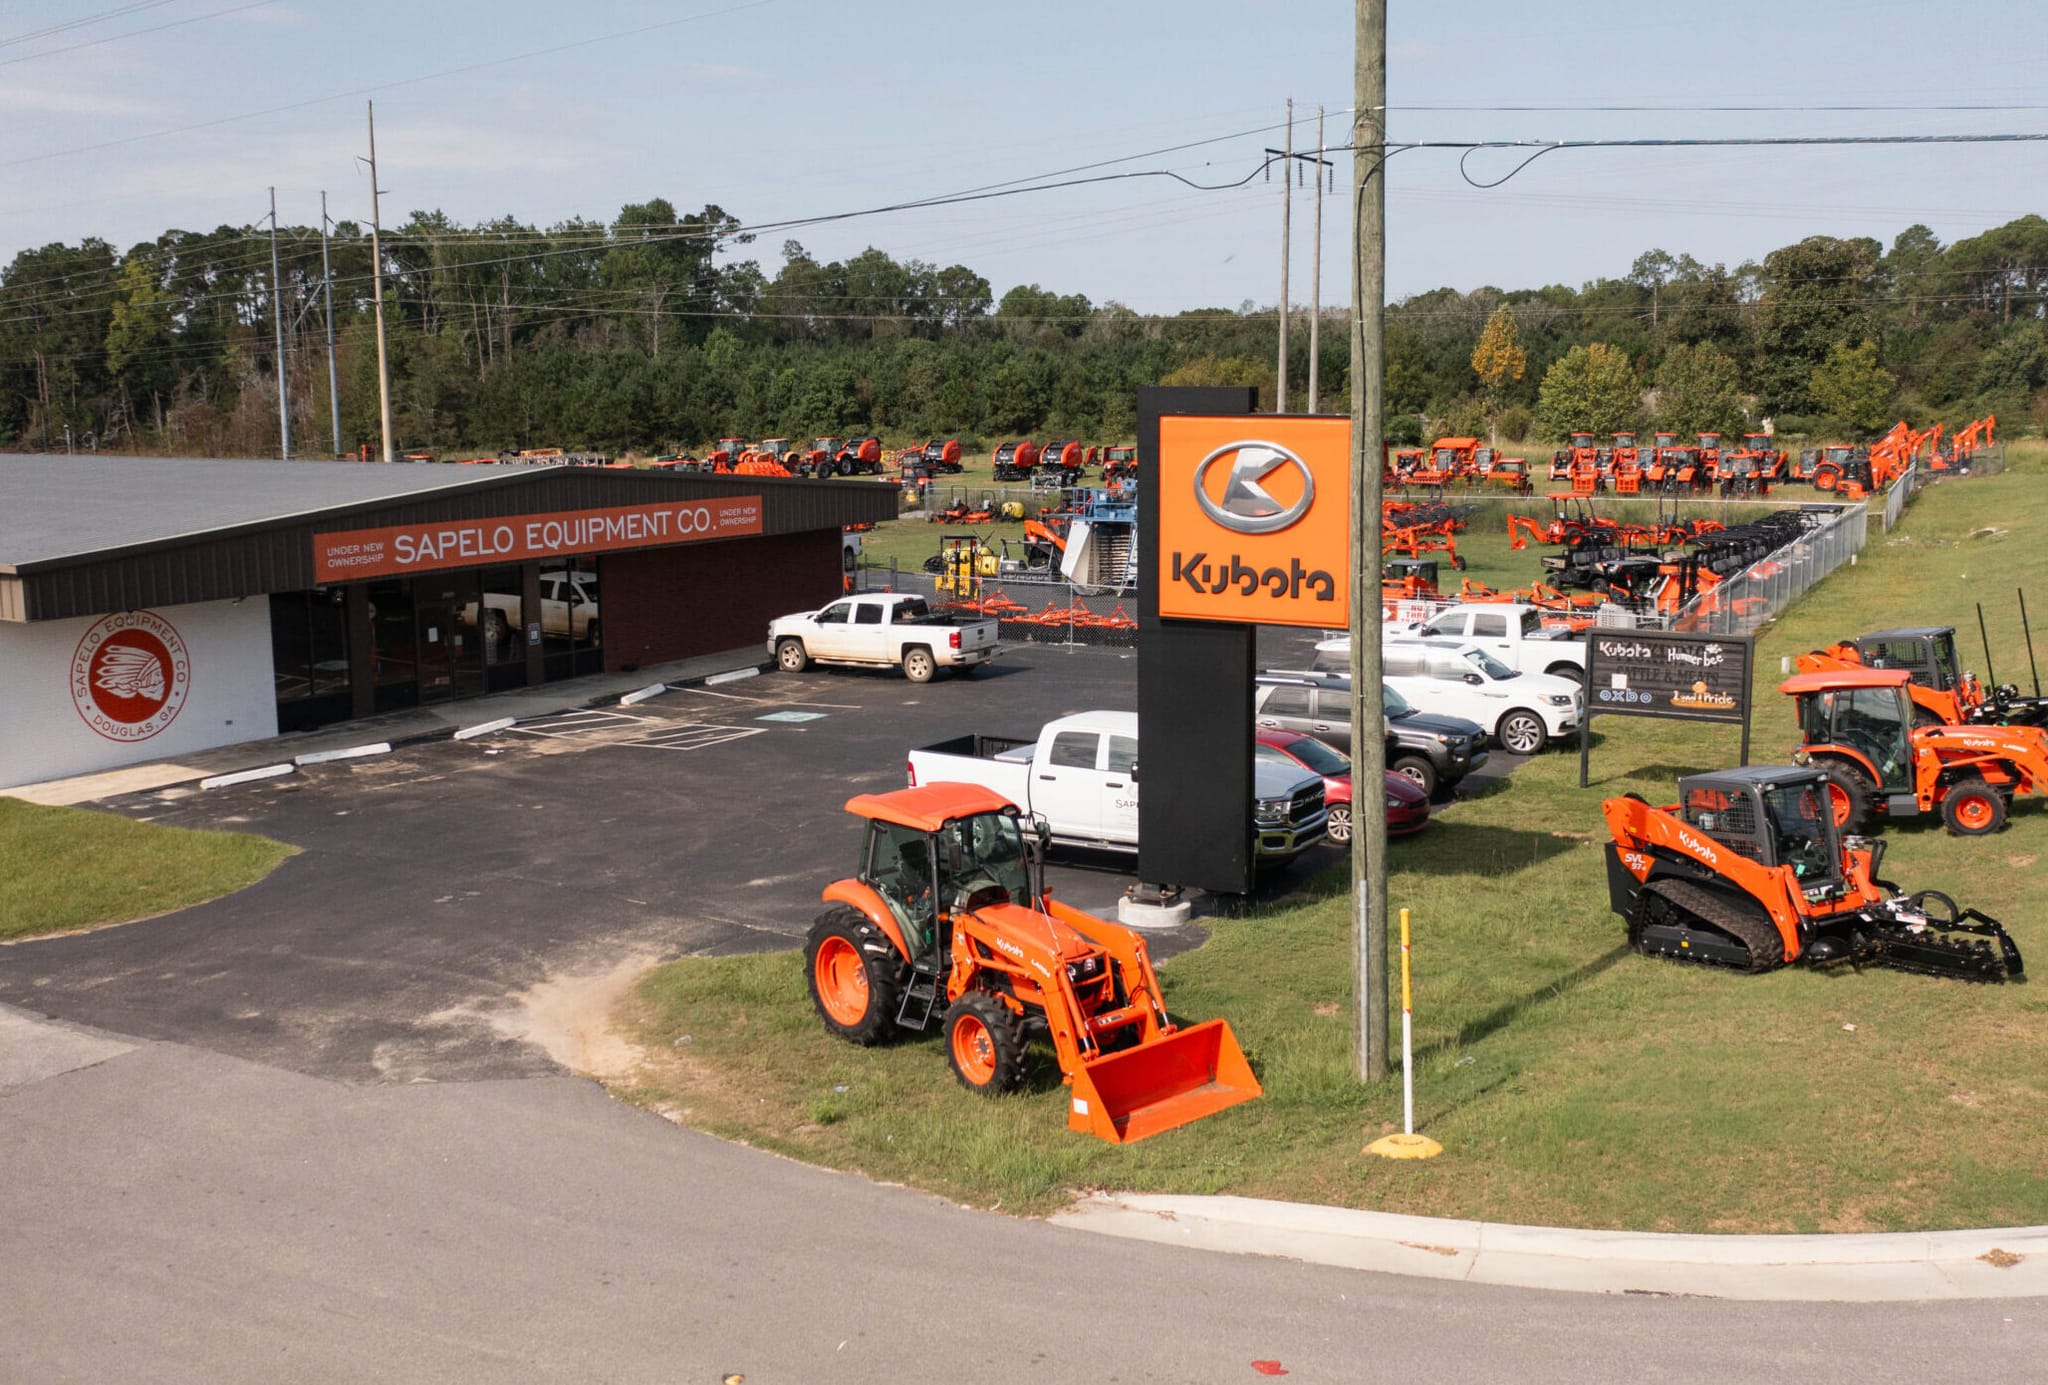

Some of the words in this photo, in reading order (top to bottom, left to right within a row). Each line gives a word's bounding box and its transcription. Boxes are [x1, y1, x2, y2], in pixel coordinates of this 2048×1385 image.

[720, 508, 741, 517] UNDER
[720, 515, 757, 527] OWNERSHIP
[394, 526, 514, 564] SAPELO
[526, 511, 672, 551] EQUIPMENT
[677, 507, 717, 532] CO.
[327, 544, 361, 557] UNDER
[363, 542, 385, 553] NEW
[327, 553, 385, 568] OWNERSHIP
[1172, 551, 1335, 602] Kubota
[76, 633, 101, 698] SAPELO
[104, 615, 183, 655] EQUIPMENT
[175, 659, 186, 683] CO
[1599, 641, 1652, 658] Kubota
[1599, 687, 1652, 704] oxbo
[160, 704, 175, 722] GA
[1115, 799, 1139, 809] SAP
[1679, 830, 1718, 864] Kubota
[1625, 853, 1646, 864] SVL
